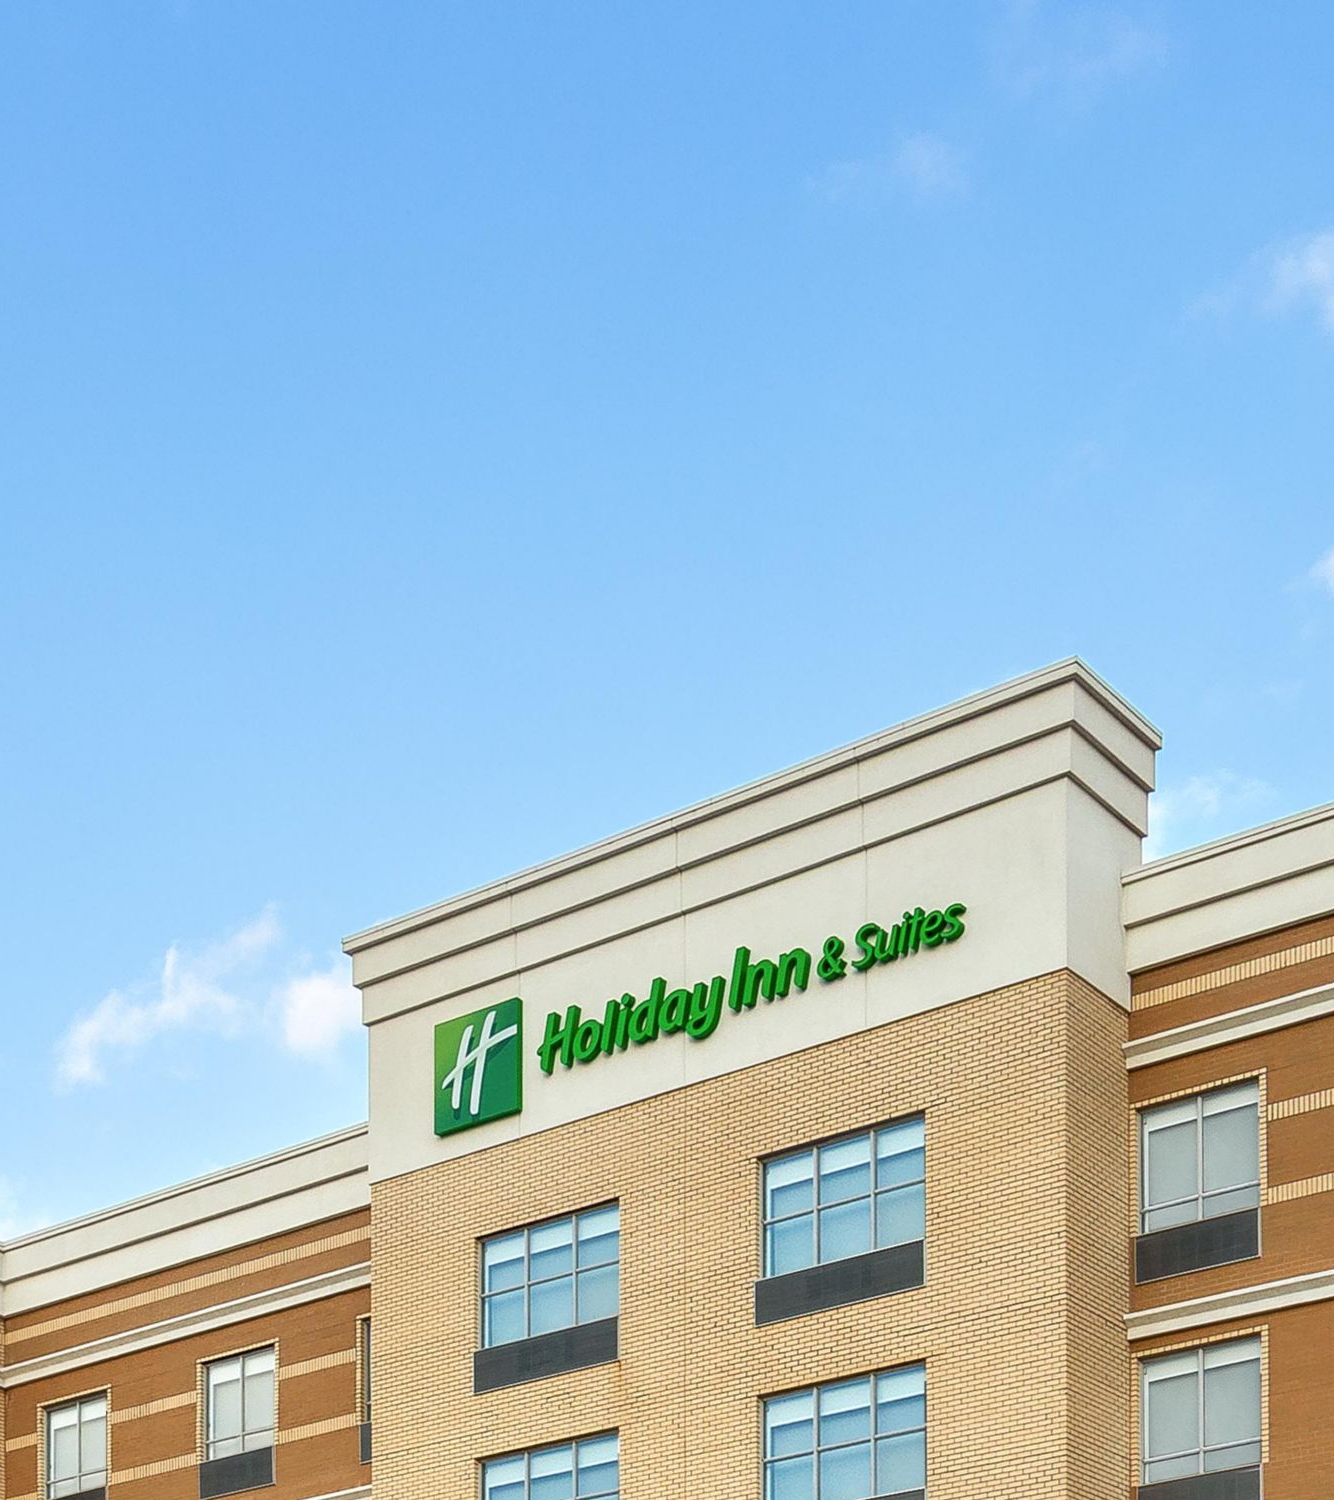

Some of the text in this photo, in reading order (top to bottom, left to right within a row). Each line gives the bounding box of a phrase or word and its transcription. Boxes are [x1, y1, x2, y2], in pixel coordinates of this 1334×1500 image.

[537, 902, 966, 1074] Holiday Inn & Suites
